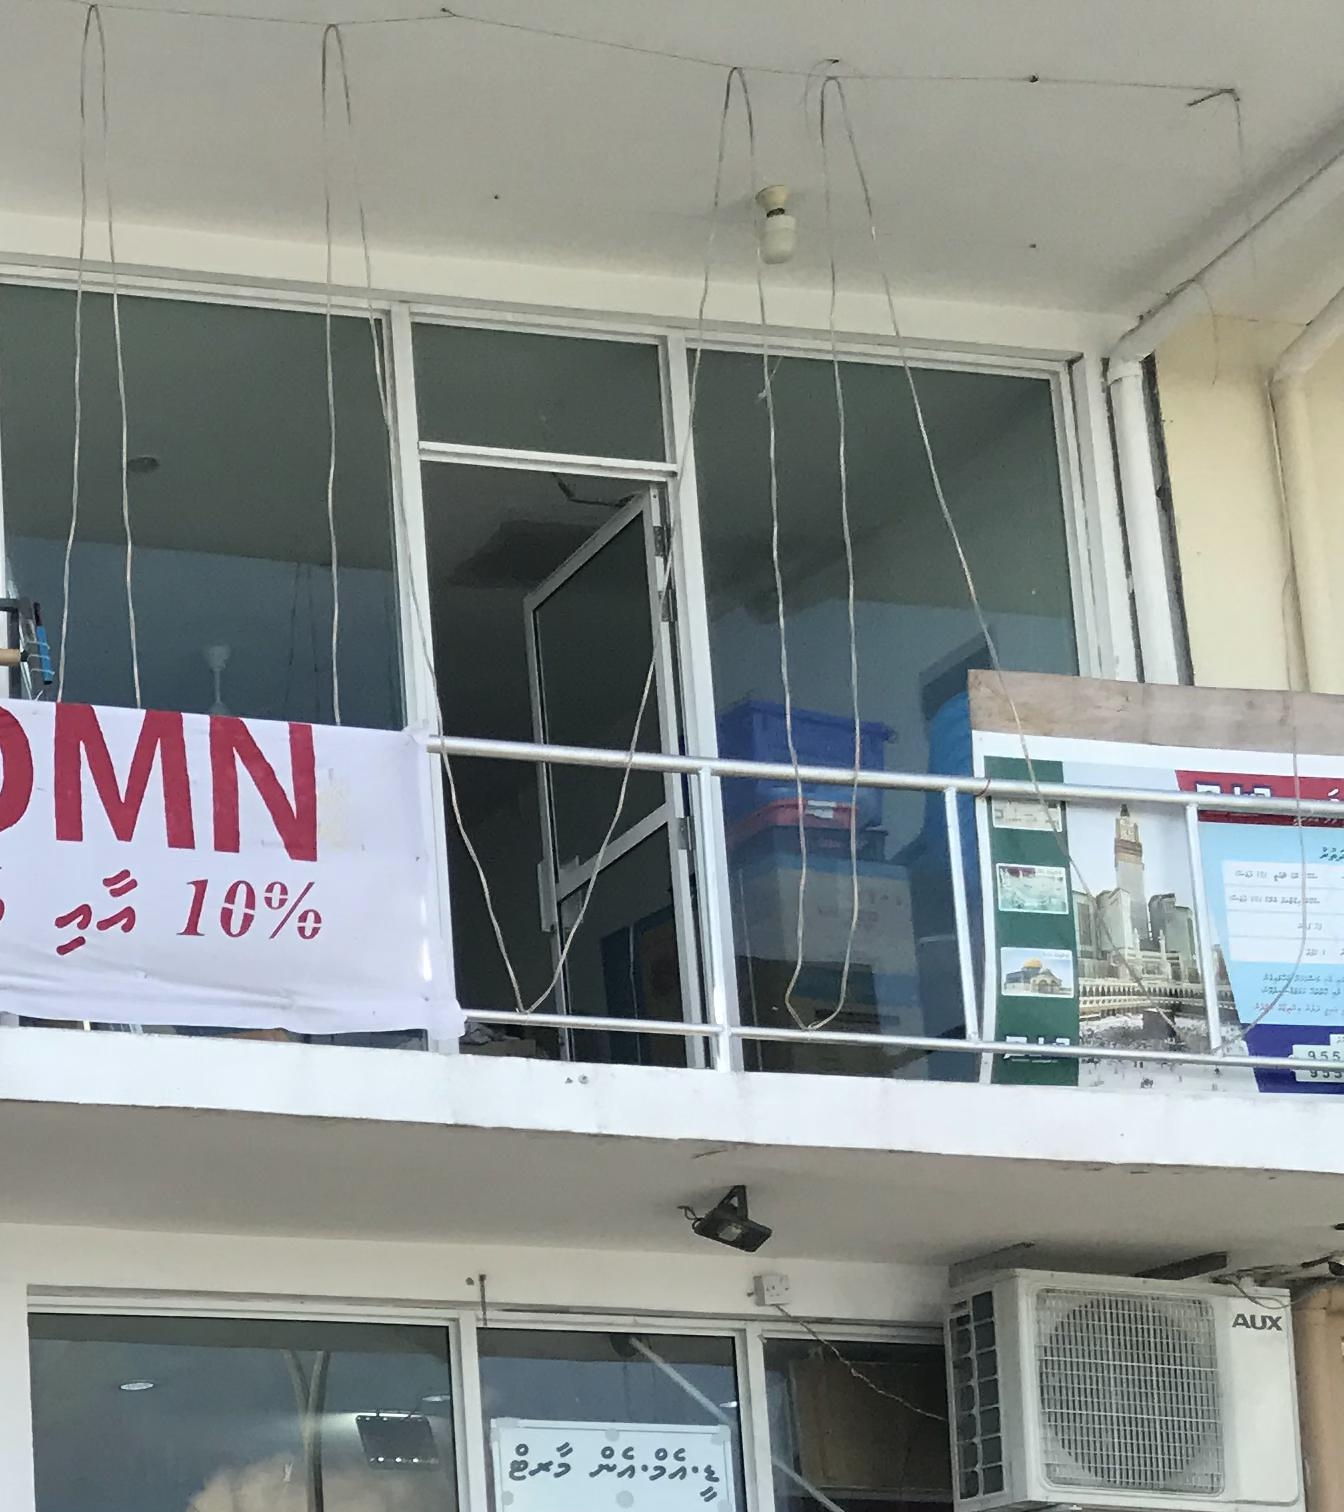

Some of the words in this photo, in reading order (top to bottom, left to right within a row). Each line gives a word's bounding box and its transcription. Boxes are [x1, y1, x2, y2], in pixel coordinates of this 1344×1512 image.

[56, 871, 137, 954] އާއި
[184, 880, 321, 938] 10%
[1232, 1313, 1283, 1331] AUX
